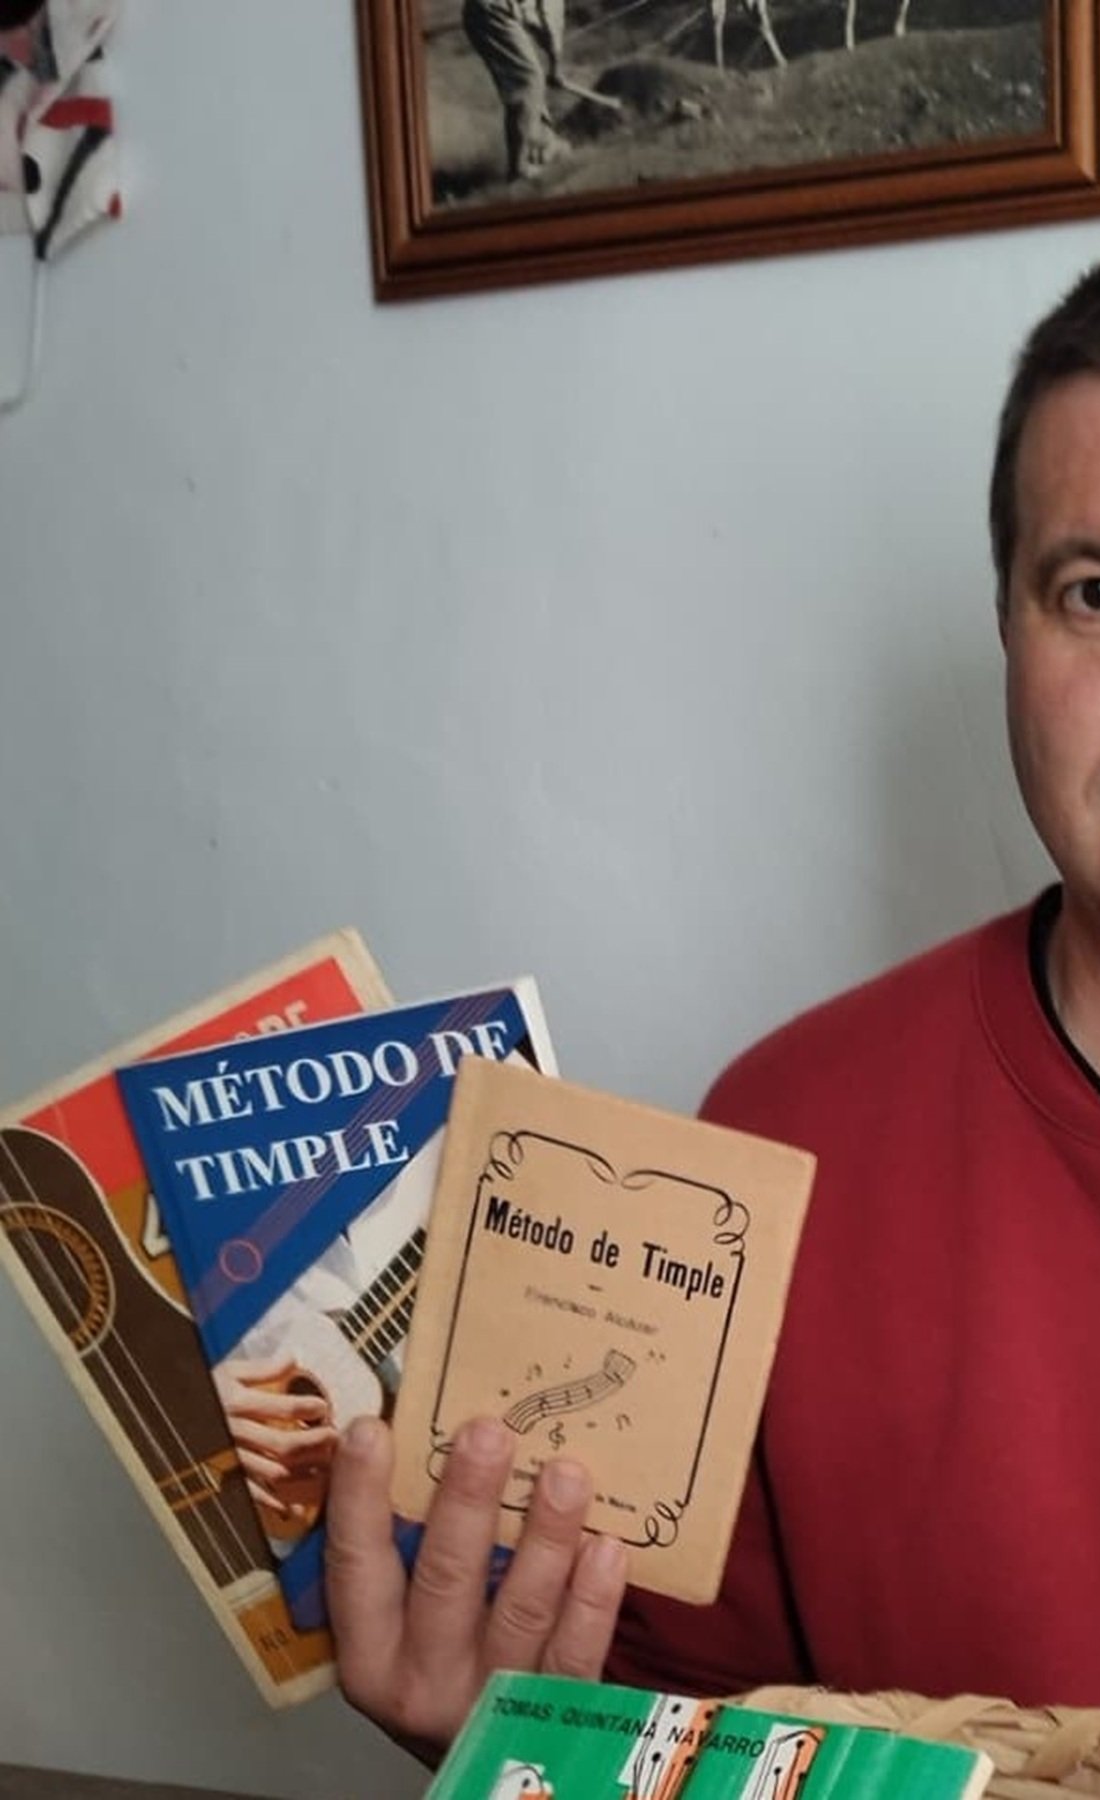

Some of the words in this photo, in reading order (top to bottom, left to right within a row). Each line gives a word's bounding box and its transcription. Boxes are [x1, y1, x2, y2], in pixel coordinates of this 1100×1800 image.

[152, 1041, 420, 1132] MÉTODO
[428, 1021, 508, 1077] DE
[176, 1119, 410, 1201] TIMPLE
[484, 1196, 574, 1255] Método
[591, 1230, 620, 1268] de
[641, 1241, 724, 1300] Timple
[494, 1697, 552, 1720] TOMAS
[560, 1707, 657, 1740] QUINTANA
[666, 1725, 766, 1759] NAVARRO
